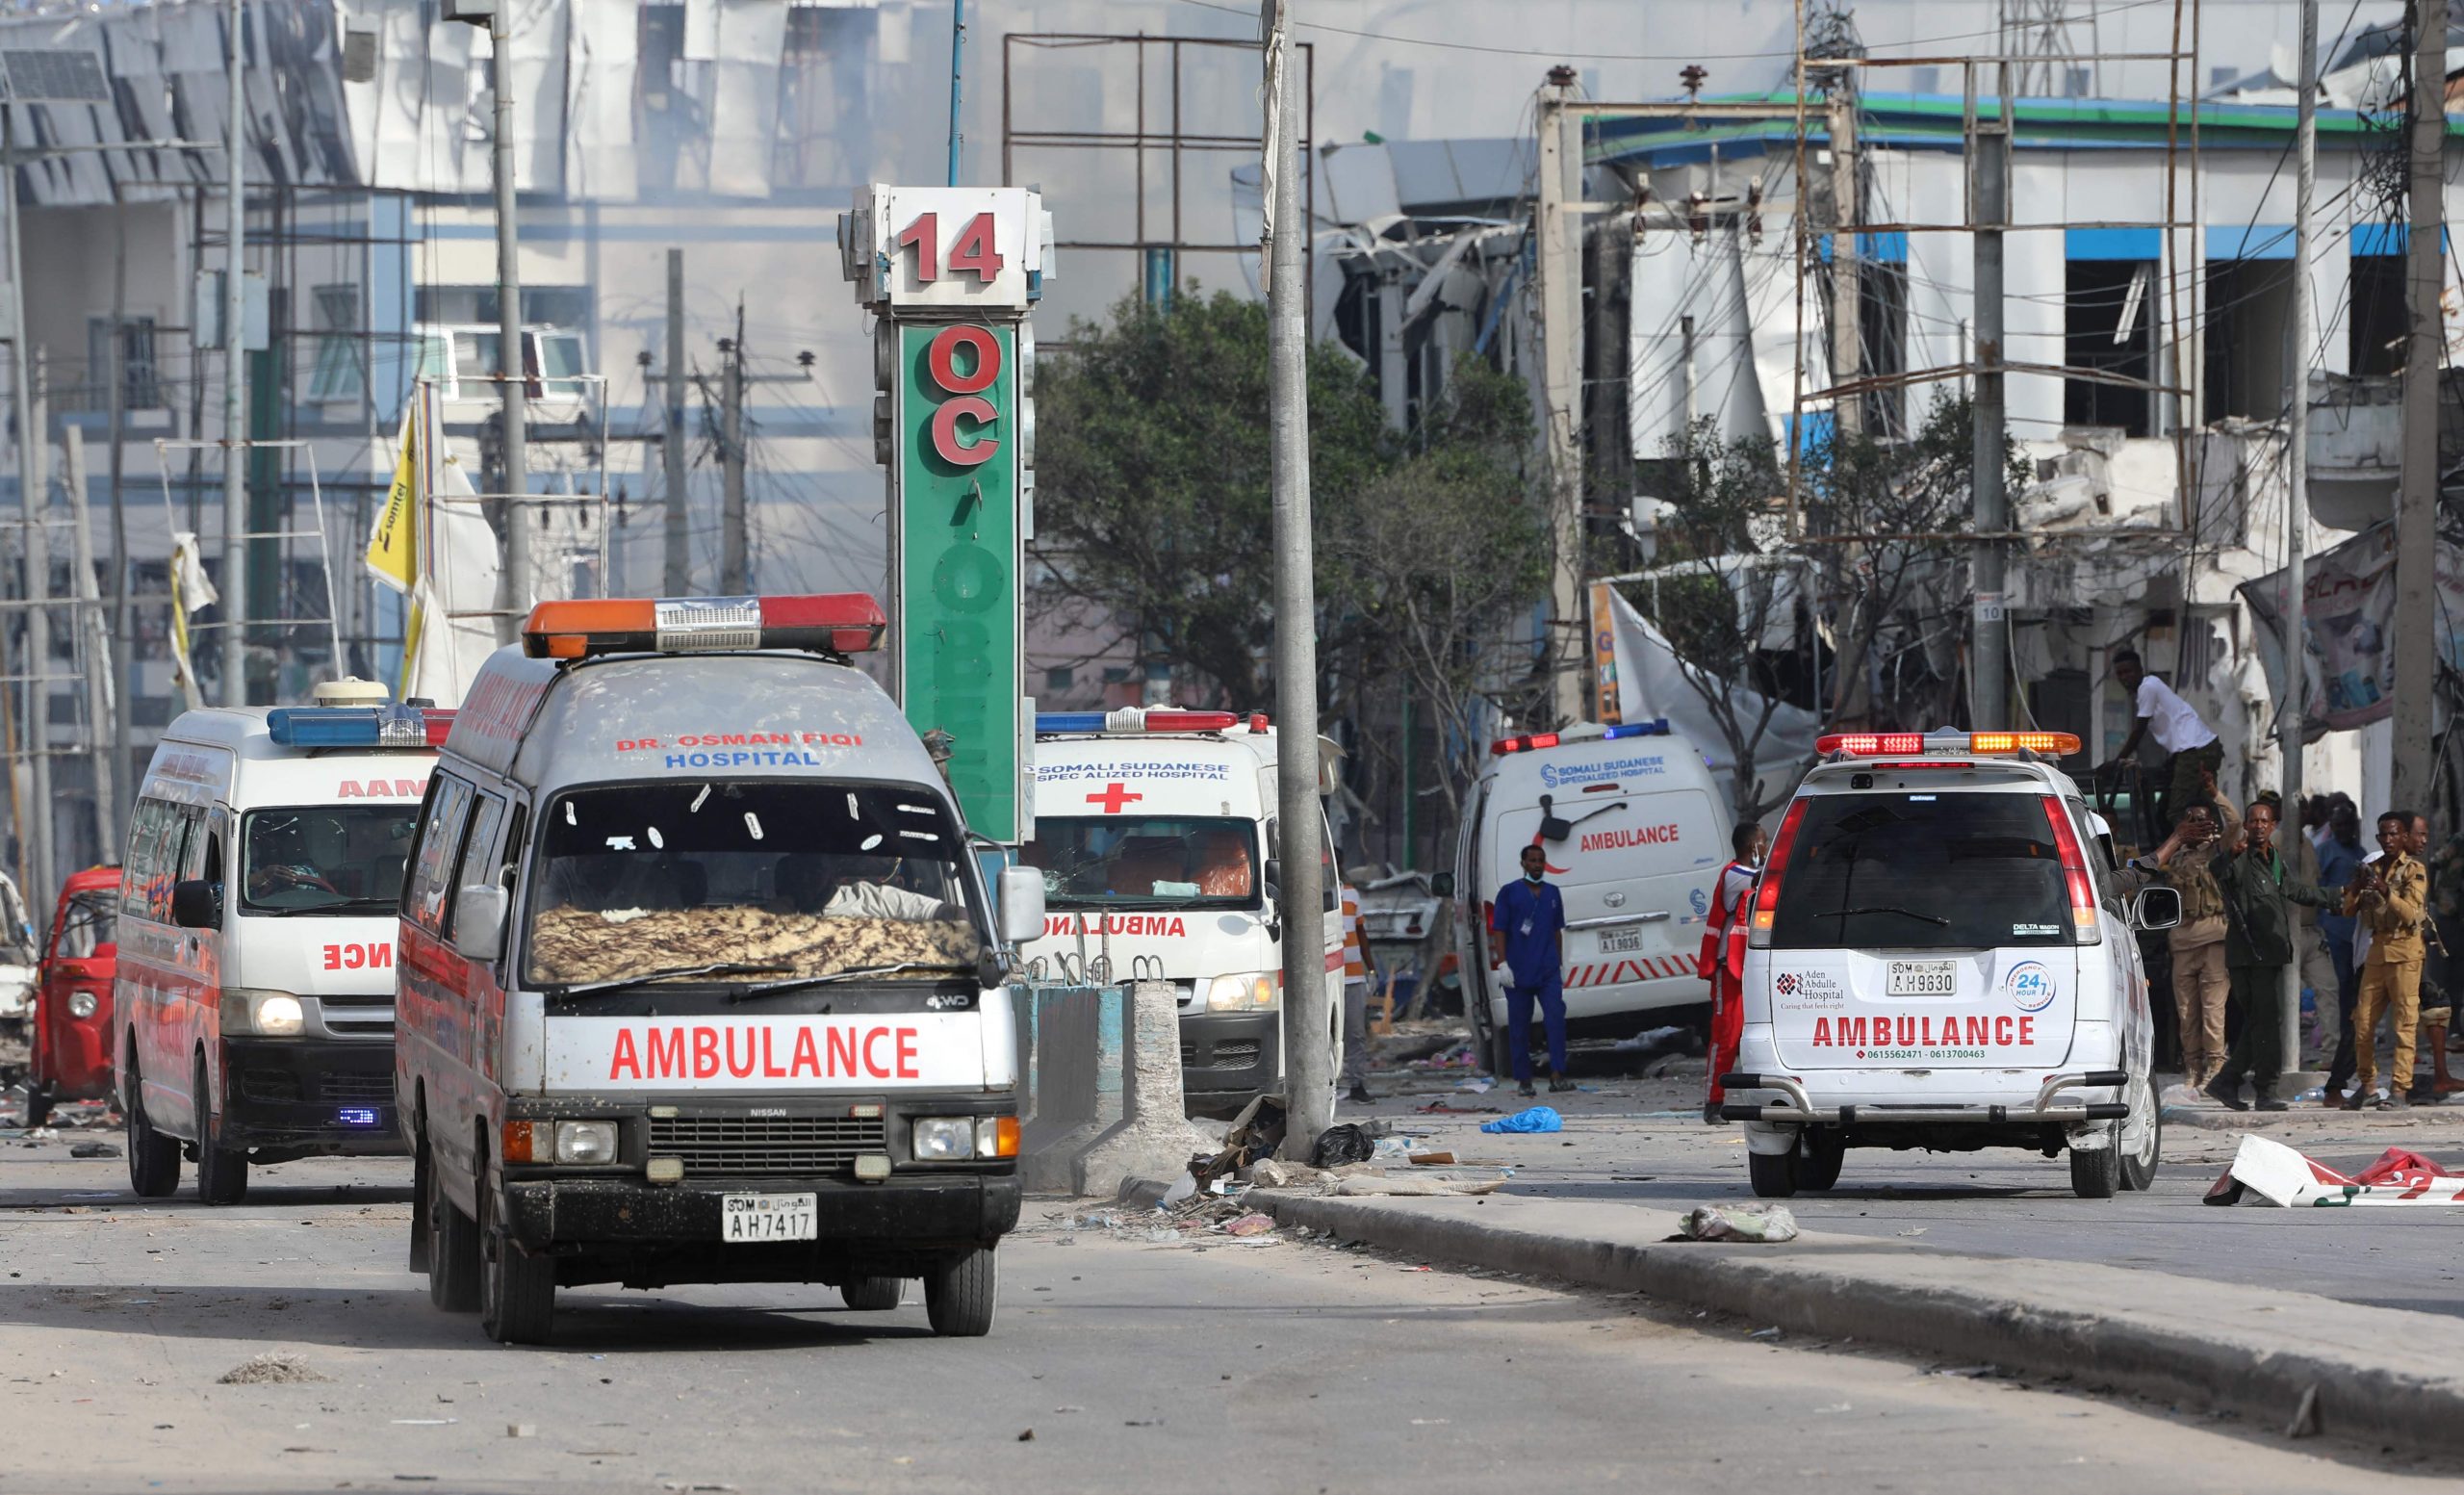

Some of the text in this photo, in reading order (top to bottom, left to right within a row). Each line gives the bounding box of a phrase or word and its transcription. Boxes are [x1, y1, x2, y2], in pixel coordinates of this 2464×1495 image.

[901, 213, 1004, 282] 14
[1984, 606, 2000, 619] 10
[617, 734, 862, 751] DR. OSMAN FIQI
[665, 752, 821, 768] HOSPITAL
[1558, 756, 1664, 776] SOMALI SUDANESE
[1039, 762, 1230, 774] SOMALI SUDANESE
[1148, 771, 1228, 780] HOSPITAL
[1559, 766, 1665, 785] SPECIALIZED HOSPITAL
[1580, 824, 1679, 852] AMBULANCE
[1805, 970, 1826, 979] Aden
[1891, 964, 1912, 974] SOM
[1805, 979, 1836, 989] Abdulle
[2016, 973, 2040, 989] 24
[1805, 990, 1844, 1001] Hospital
[1830, 1001, 1844, 1010] right
[1812, 1016, 2035, 1047] AMBULANCE
[609, 1026, 920, 1080] AMBULANCE
[1867, 1049, 1923, 1059] 0615562471
[1930, 1049, 1986, 1058] 0613700463
[750, 1107, 787, 1117] NISSAN
[727, 1199, 756, 1212] SOM
